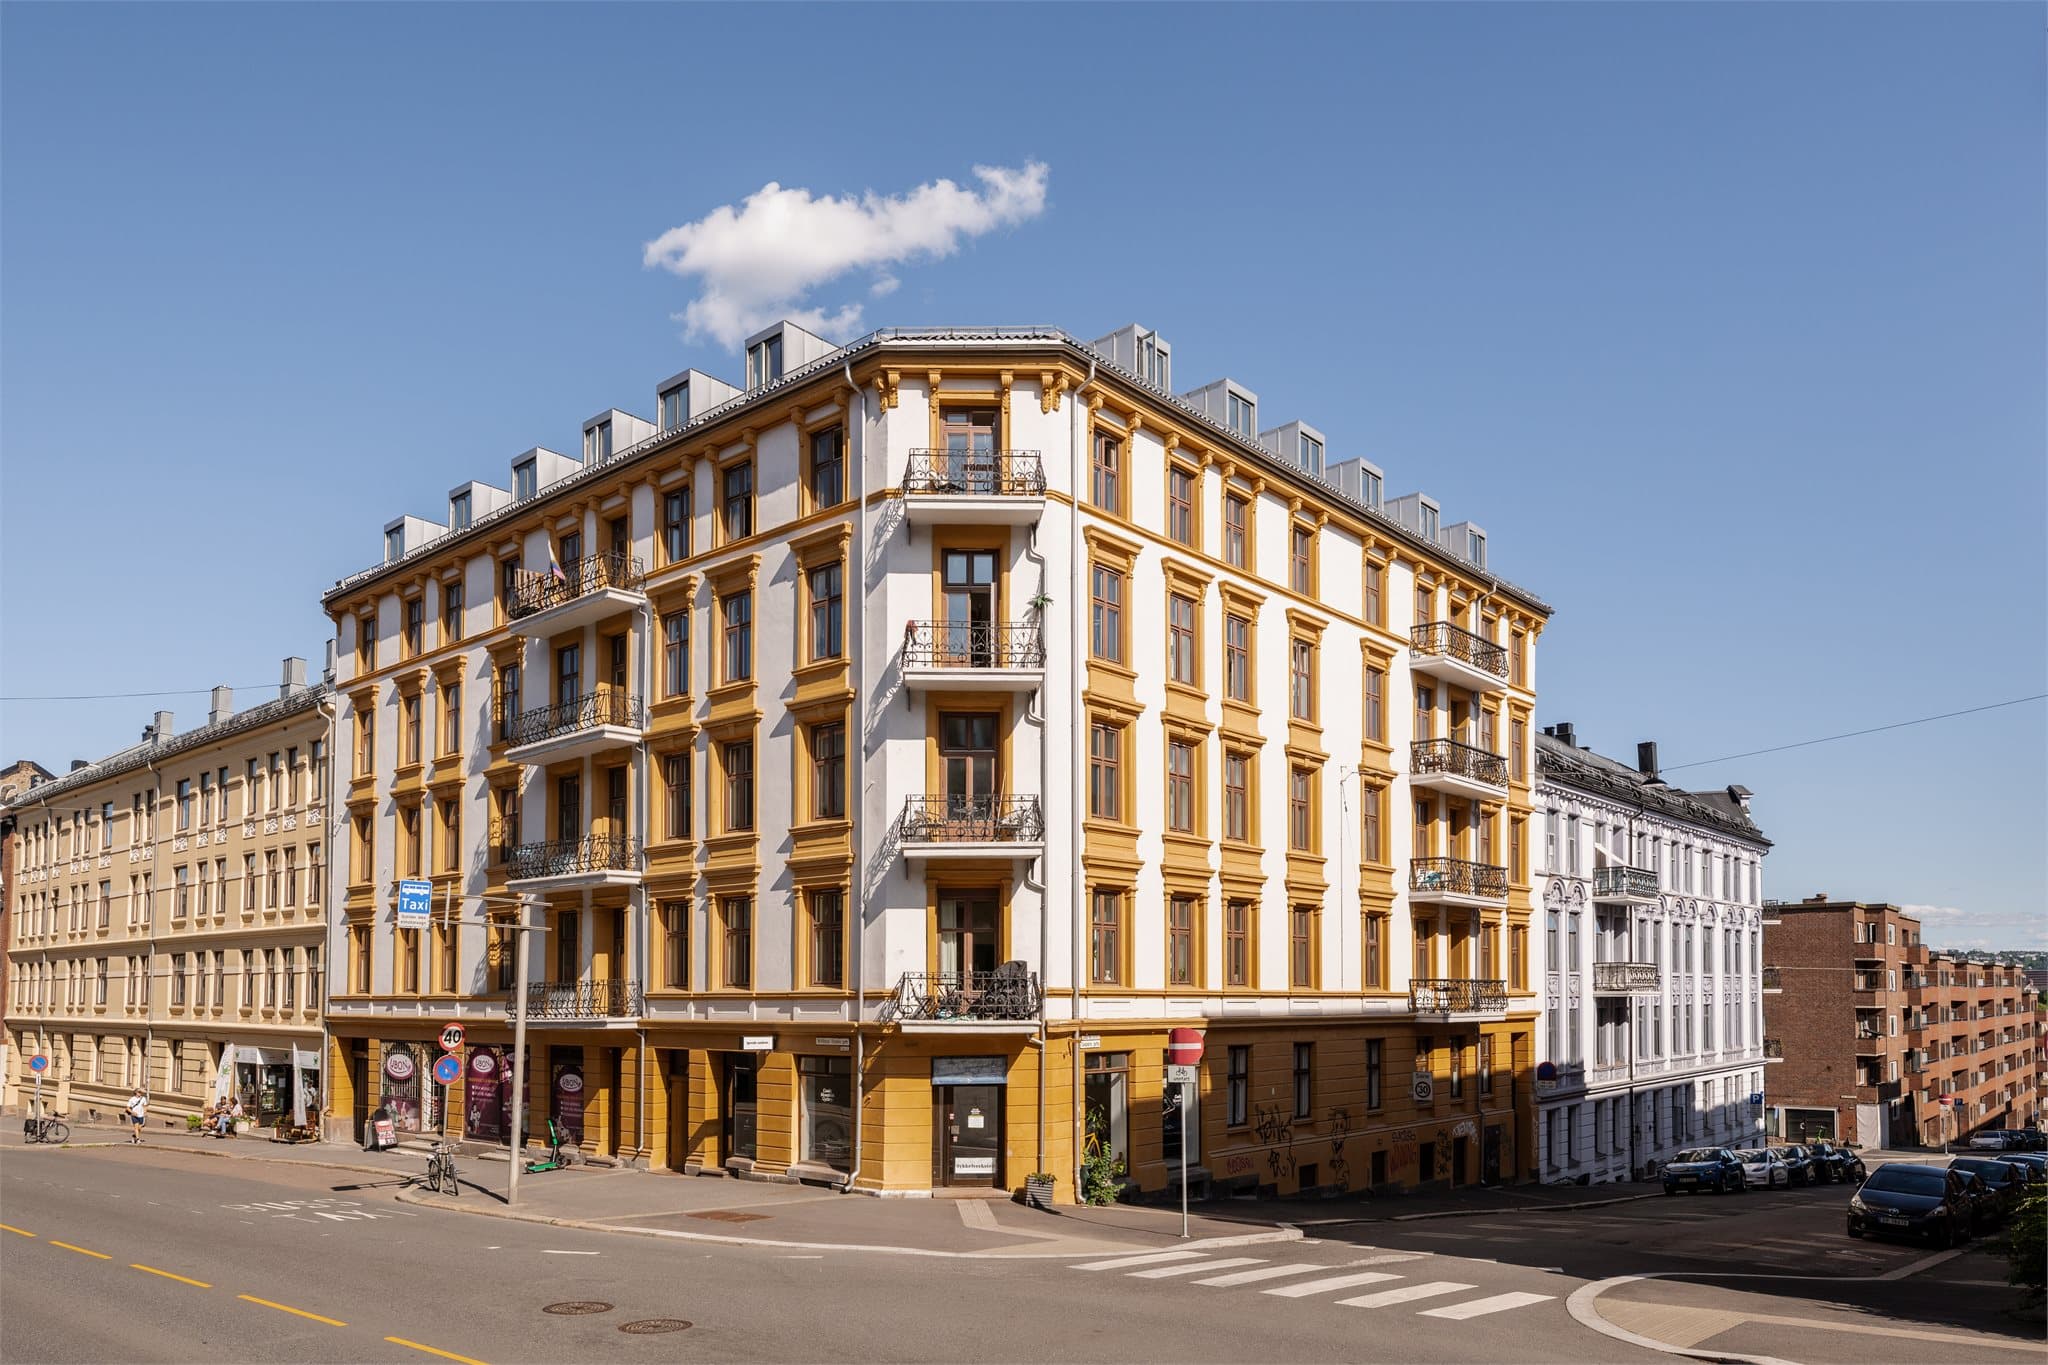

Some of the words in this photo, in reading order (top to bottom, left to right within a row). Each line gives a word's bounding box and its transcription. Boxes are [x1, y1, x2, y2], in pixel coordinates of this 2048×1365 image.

[402, 897, 428, 911] Taxi
[444, 1029, 462, 1044] 40
[1418, 1085, 1428, 1094] 30
[1752, 1094, 1760, 1103] P
[219, 1198, 363, 1213] BUSS
[271, 1208, 419, 1223] TAXI
